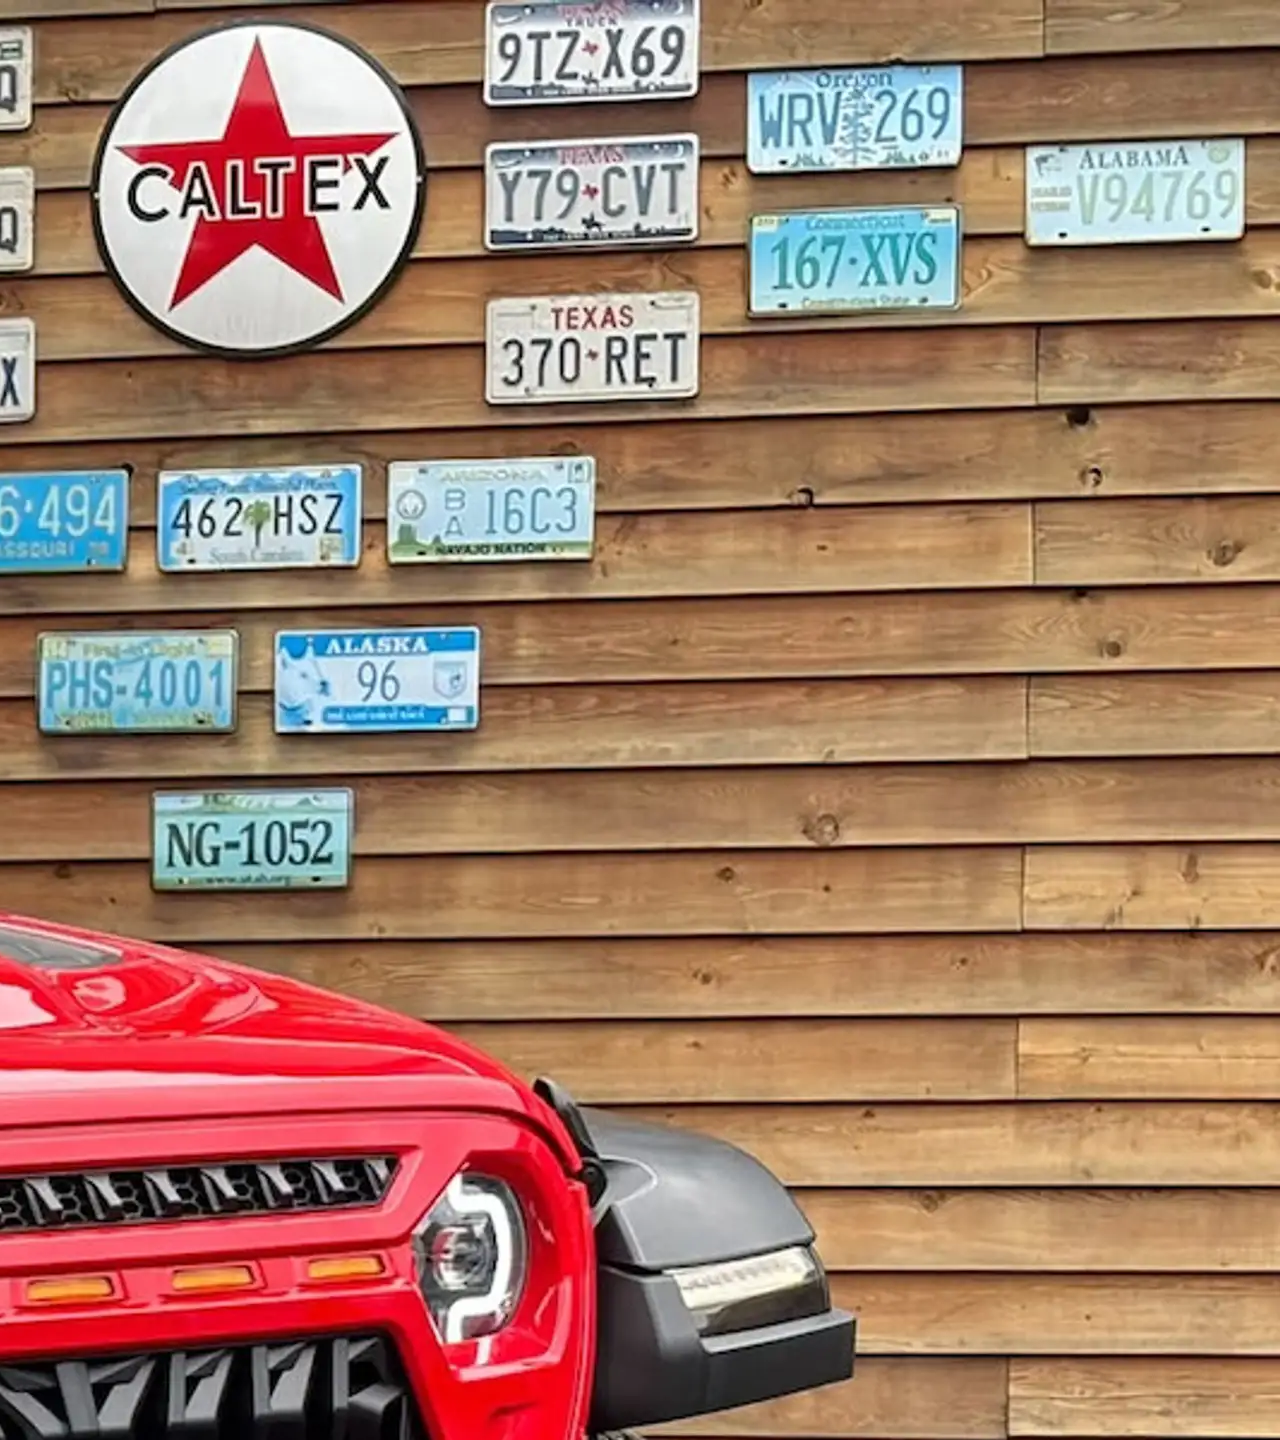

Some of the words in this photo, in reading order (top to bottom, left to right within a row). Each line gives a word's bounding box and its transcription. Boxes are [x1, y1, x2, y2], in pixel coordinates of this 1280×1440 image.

[816, 71, 893, 90] Oregon
[759, 91, 842, 148] WRV
[874, 87, 950, 143] 269
[559, 147, 627, 165] TEXAS
[1080, 146, 1189, 169] ALABAMA
[126, 156, 392, 223] CALTEX
[1077, 169, 1237, 225] V94769
[551, 305, 634, 330] TEXAS
[502, 337, 580, 387] 370
[605, 333, 686, 384] RET
[171, 497, 243, 538] 462
[273, 494, 343, 536] HSZ
[436, 544, 490, 555] NAVAJO
[494, 542, 545, 554] NATION
[326, 637, 428, 654] ALASKA
[47, 660, 223, 708] PHS-4001
[358, 660, 400, 702] 96
[166, 819, 334, 867] NG-1052
